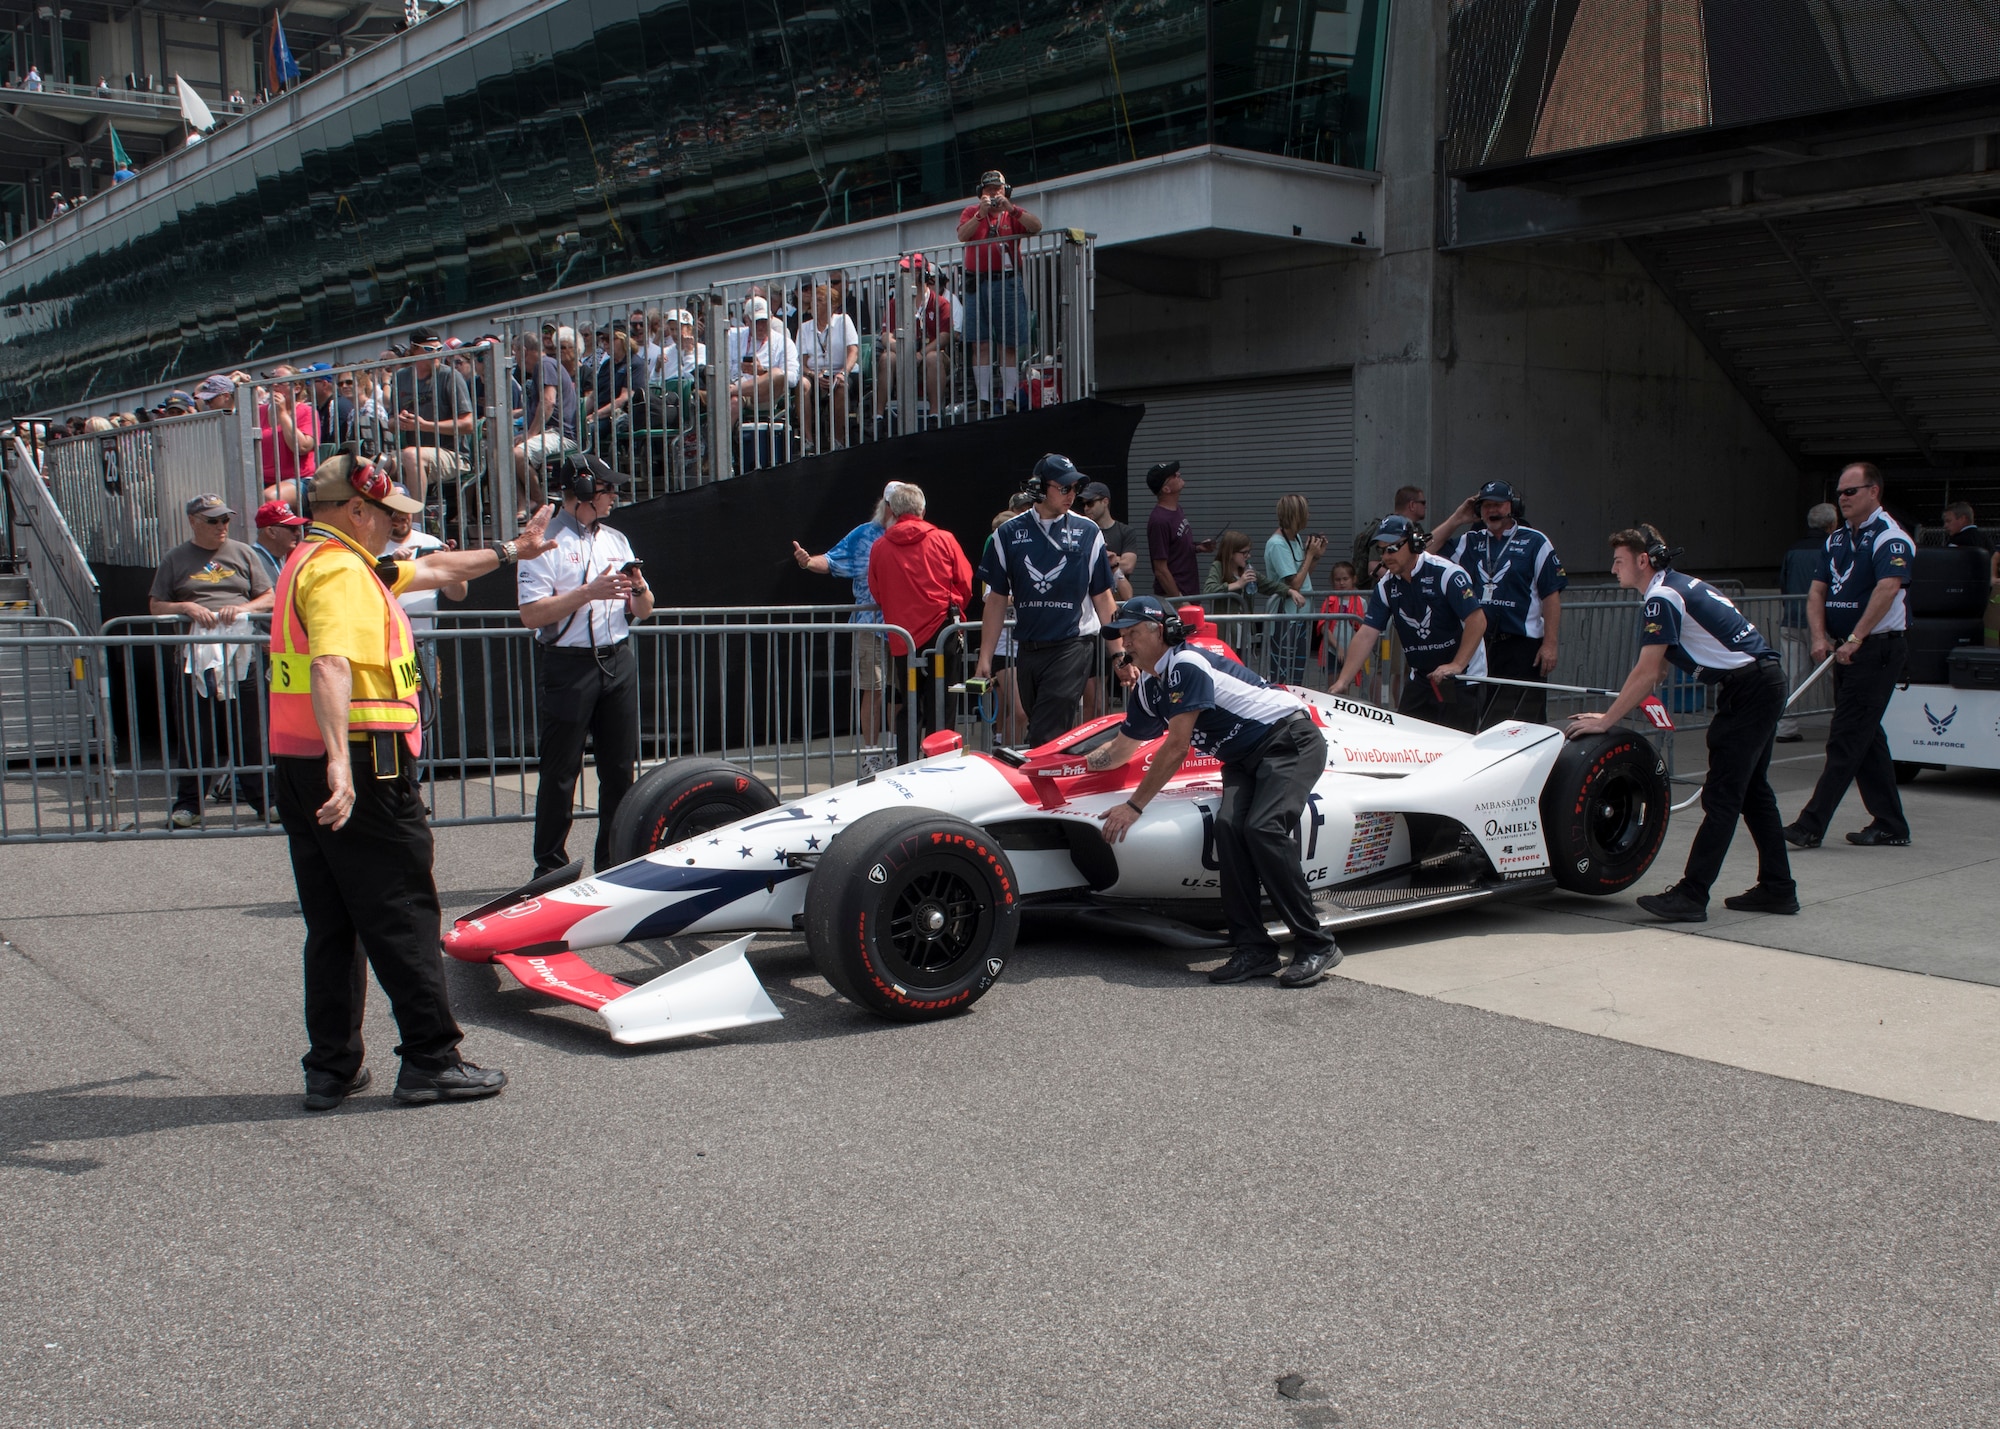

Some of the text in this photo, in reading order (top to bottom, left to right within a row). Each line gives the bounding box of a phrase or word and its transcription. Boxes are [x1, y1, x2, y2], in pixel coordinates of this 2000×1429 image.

[105, 450, 118, 482] 28
[1043, 601, 1074, 610] FORCE
[1428, 639, 1456, 650] FORCE
[1333, 698, 1395, 725] HONDA
[1645, 704, 1672, 727] 17
[1185, 758, 1221, 768] DIABETES
[1063, 765, 1087, 776] Fritz
[1474, 796, 1537, 811] AMBASSADOR
[1517, 843, 1537, 851] verizon
[1499, 854, 1540, 865] Firestone
[931, 831, 1013, 905] Firestone
[1503, 868, 1545, 880] Firestone
[871, 976, 970, 1009] FIREHAWK
